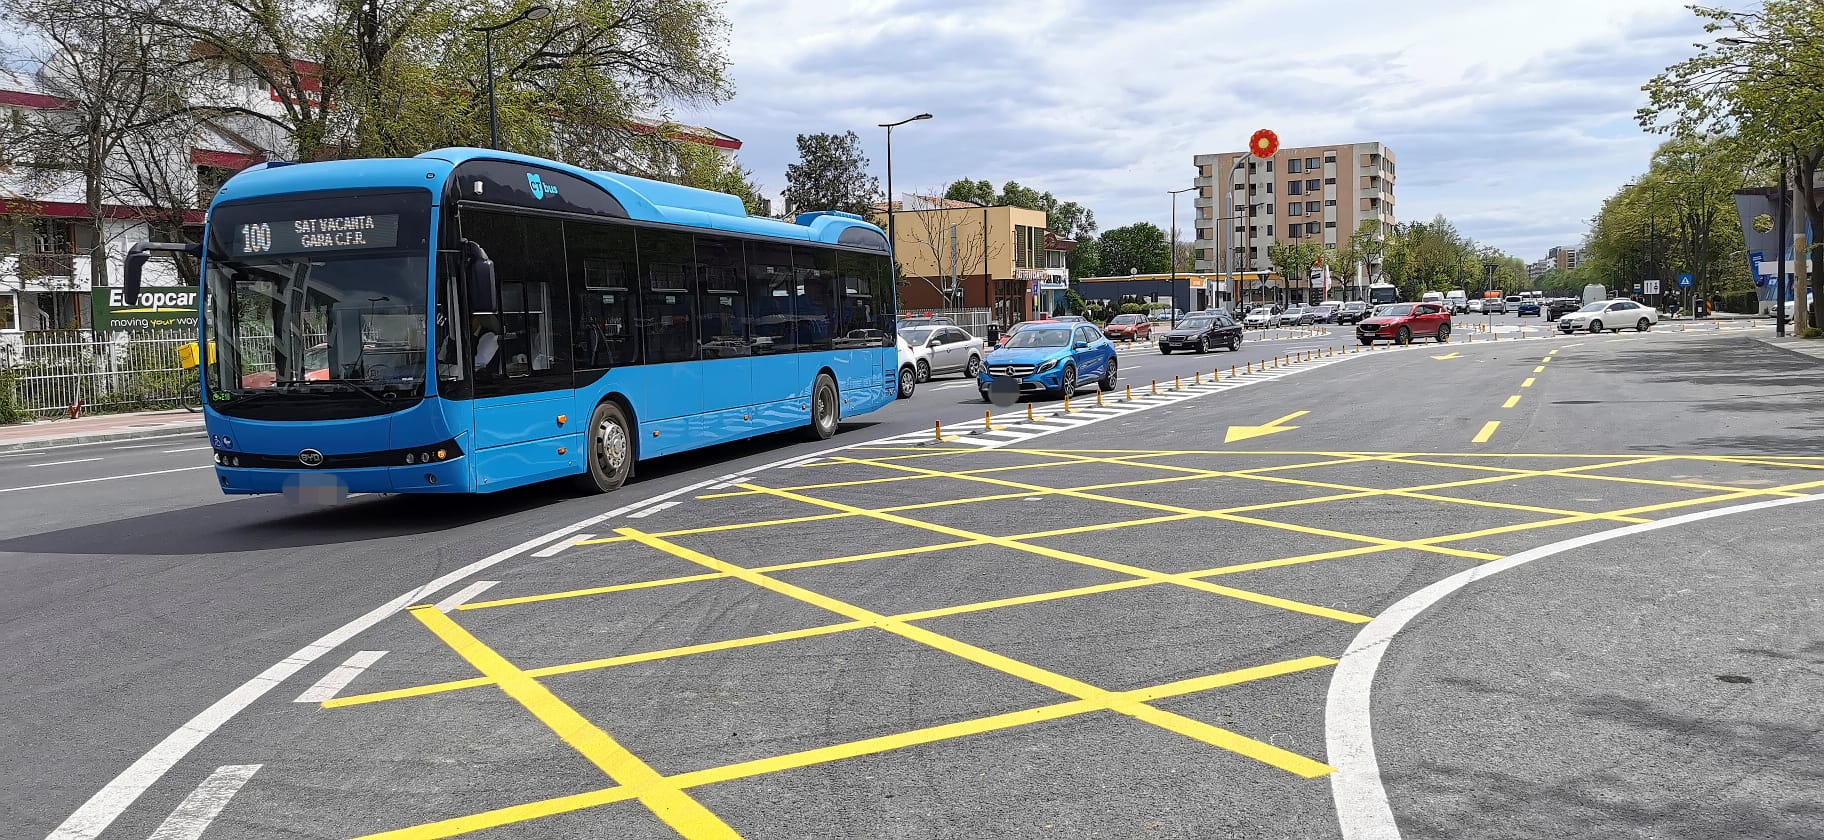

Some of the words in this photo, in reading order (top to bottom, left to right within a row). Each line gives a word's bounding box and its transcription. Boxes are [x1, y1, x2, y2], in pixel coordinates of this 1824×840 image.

[294, 219, 317, 234] SAT
[319, 215, 375, 232] VACANTA
[242, 222, 272, 253] 100
[301, 233, 333, 248] GARA
[335, 231, 366, 246] C.F.R.
[110, 317, 149, 328] moving
[150, 319, 176, 328] your
[176, 317, 199, 326] way
[300, 453, 321, 462] BYD
